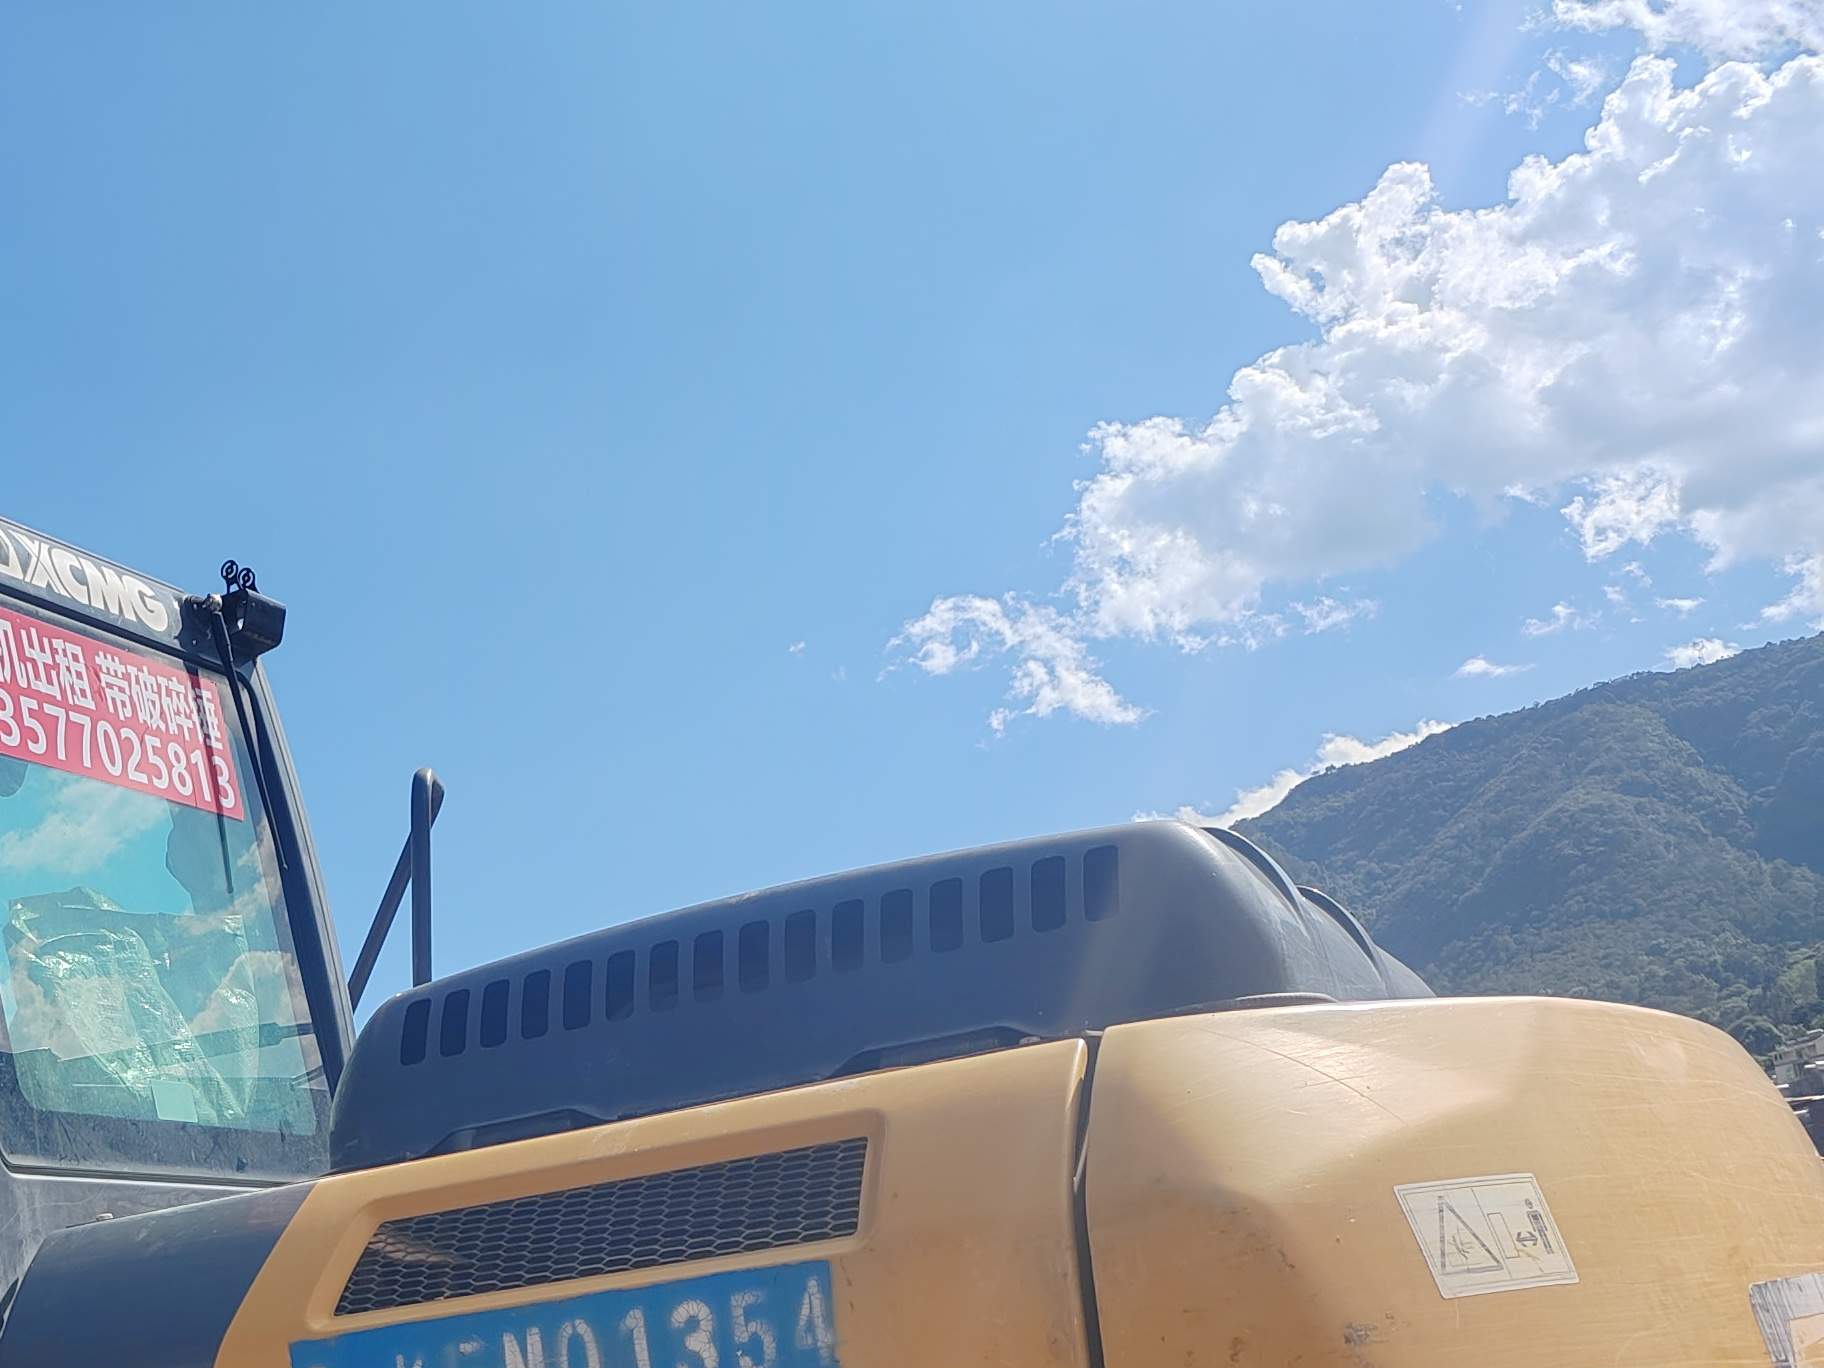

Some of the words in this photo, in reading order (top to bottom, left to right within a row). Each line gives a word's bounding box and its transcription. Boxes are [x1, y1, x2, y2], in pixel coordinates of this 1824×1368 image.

[8, 530, 169, 632] XCMG
[94, 651, 223, 750] 带破碎锤
